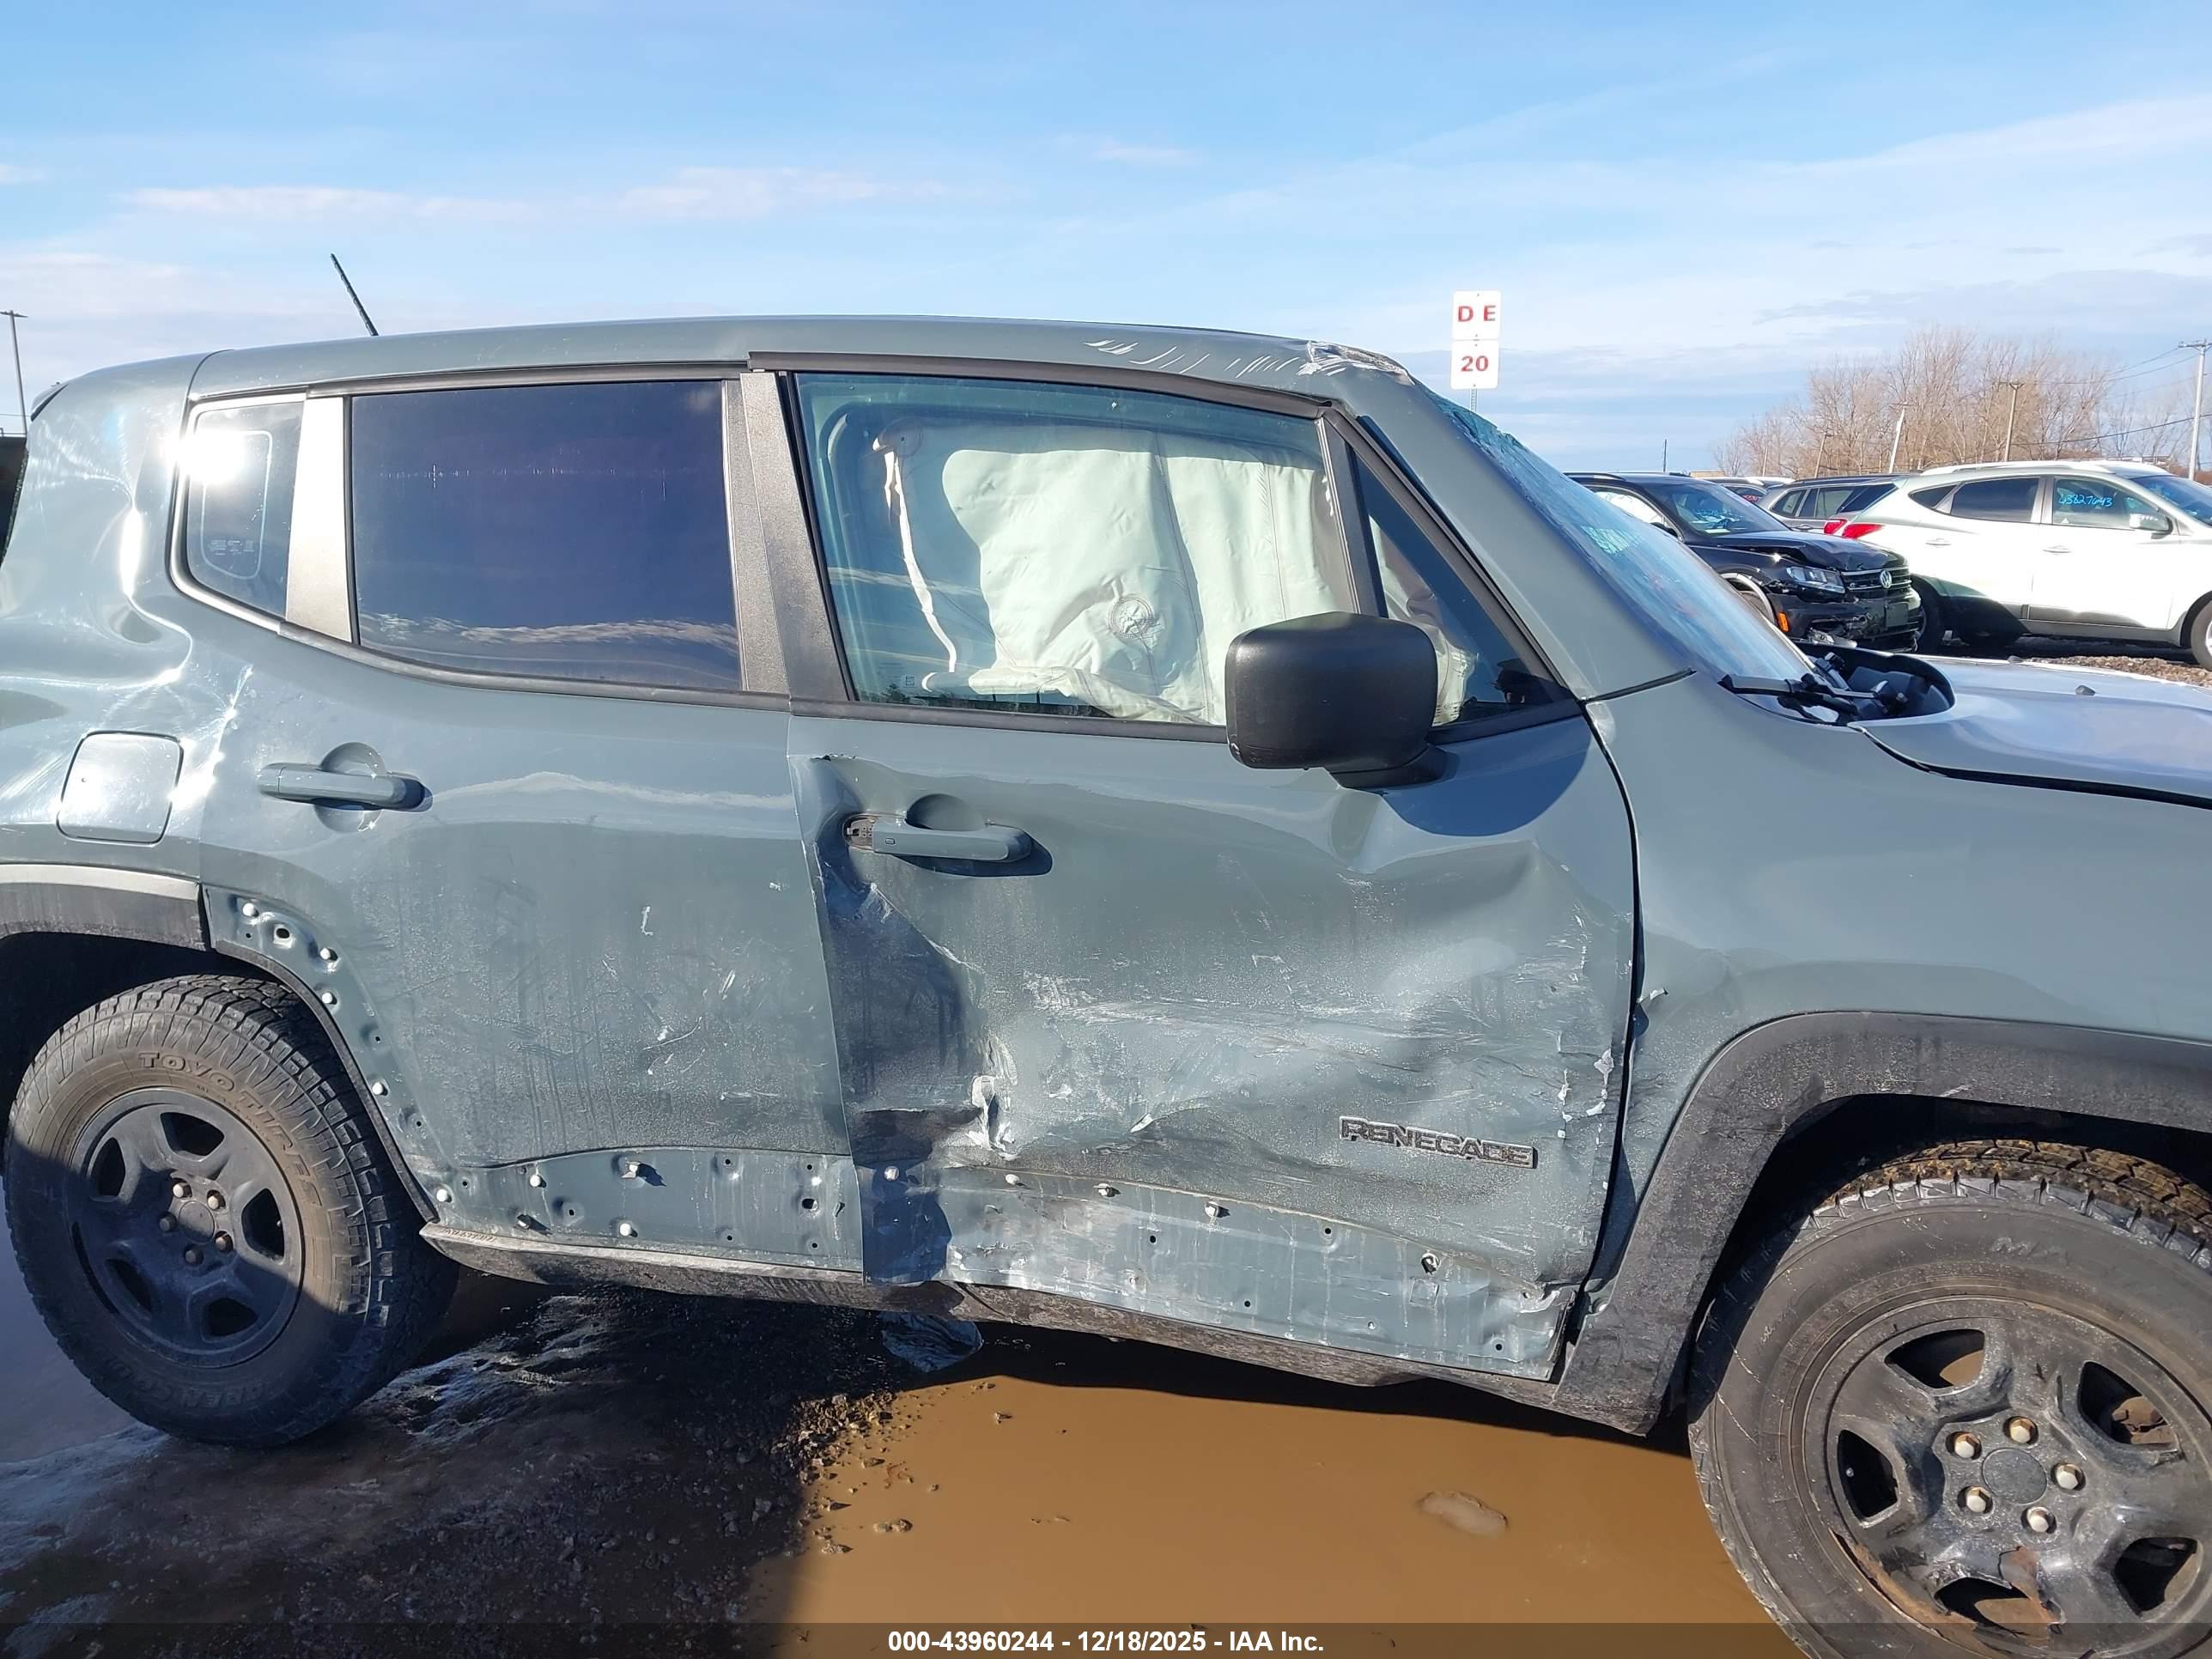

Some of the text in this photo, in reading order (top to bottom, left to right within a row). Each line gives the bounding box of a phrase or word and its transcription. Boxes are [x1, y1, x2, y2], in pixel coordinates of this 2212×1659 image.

[1457, 305, 1497, 323] D E
[1461, 355, 1489, 373] 20
[138, 1052, 234, 1092] TOYO
[238, 1089, 323, 1207] TIRES
[1339, 1115, 1536, 1170] RENEGADE
